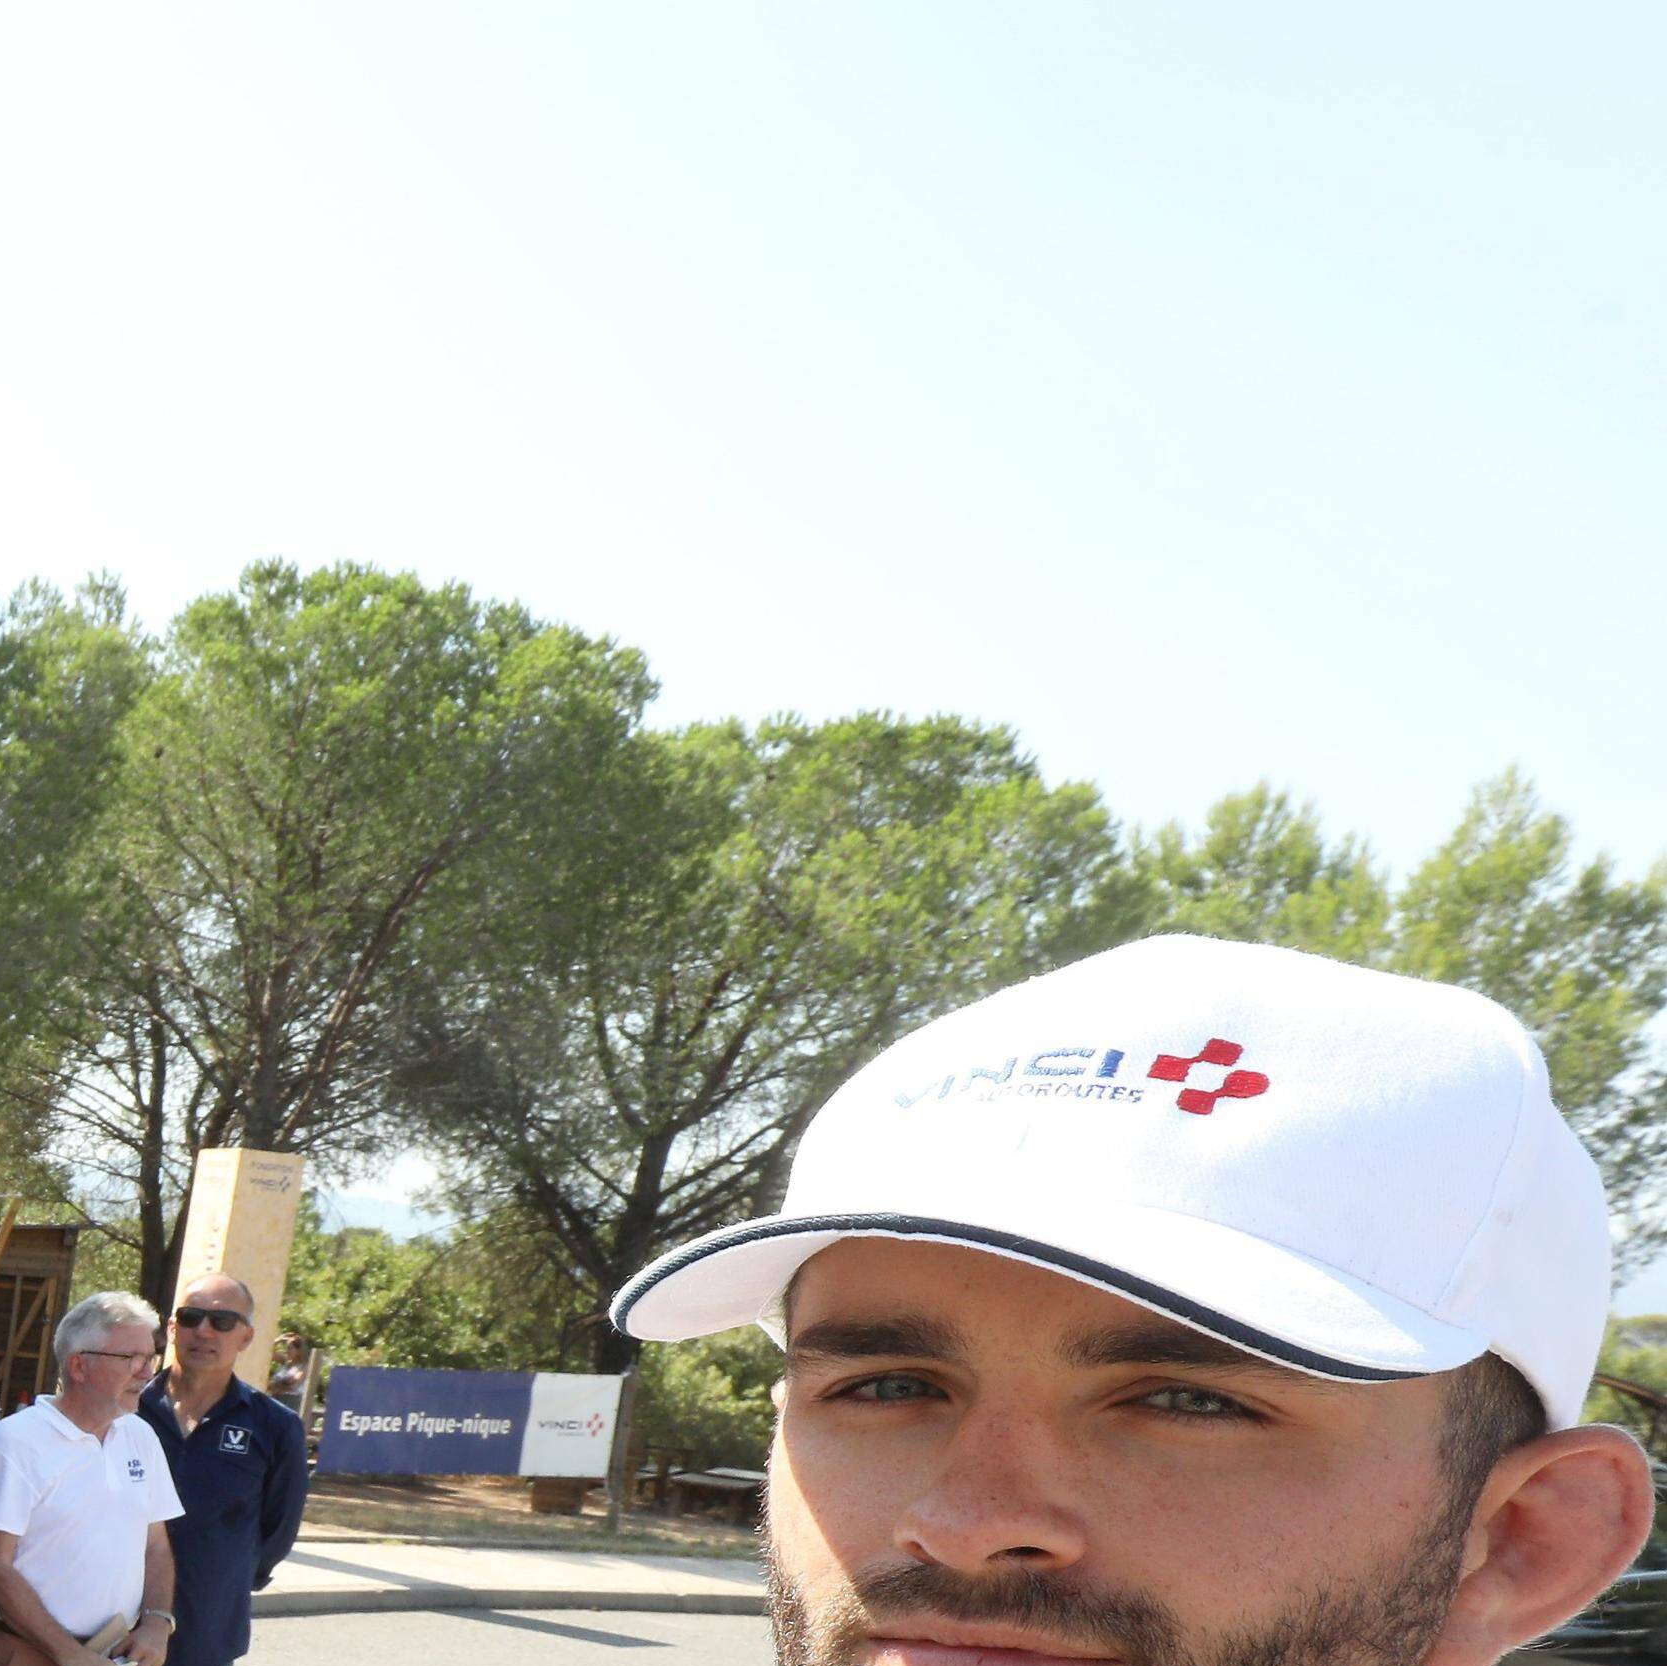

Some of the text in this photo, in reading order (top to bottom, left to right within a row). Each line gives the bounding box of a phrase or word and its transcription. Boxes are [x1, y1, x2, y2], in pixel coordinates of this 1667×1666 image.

[894, 1048, 1126, 1109] VINCI
[339, 1410, 512, 1439] Espace Pique-nique
[538, 1420, 583, 1430] VINCI
